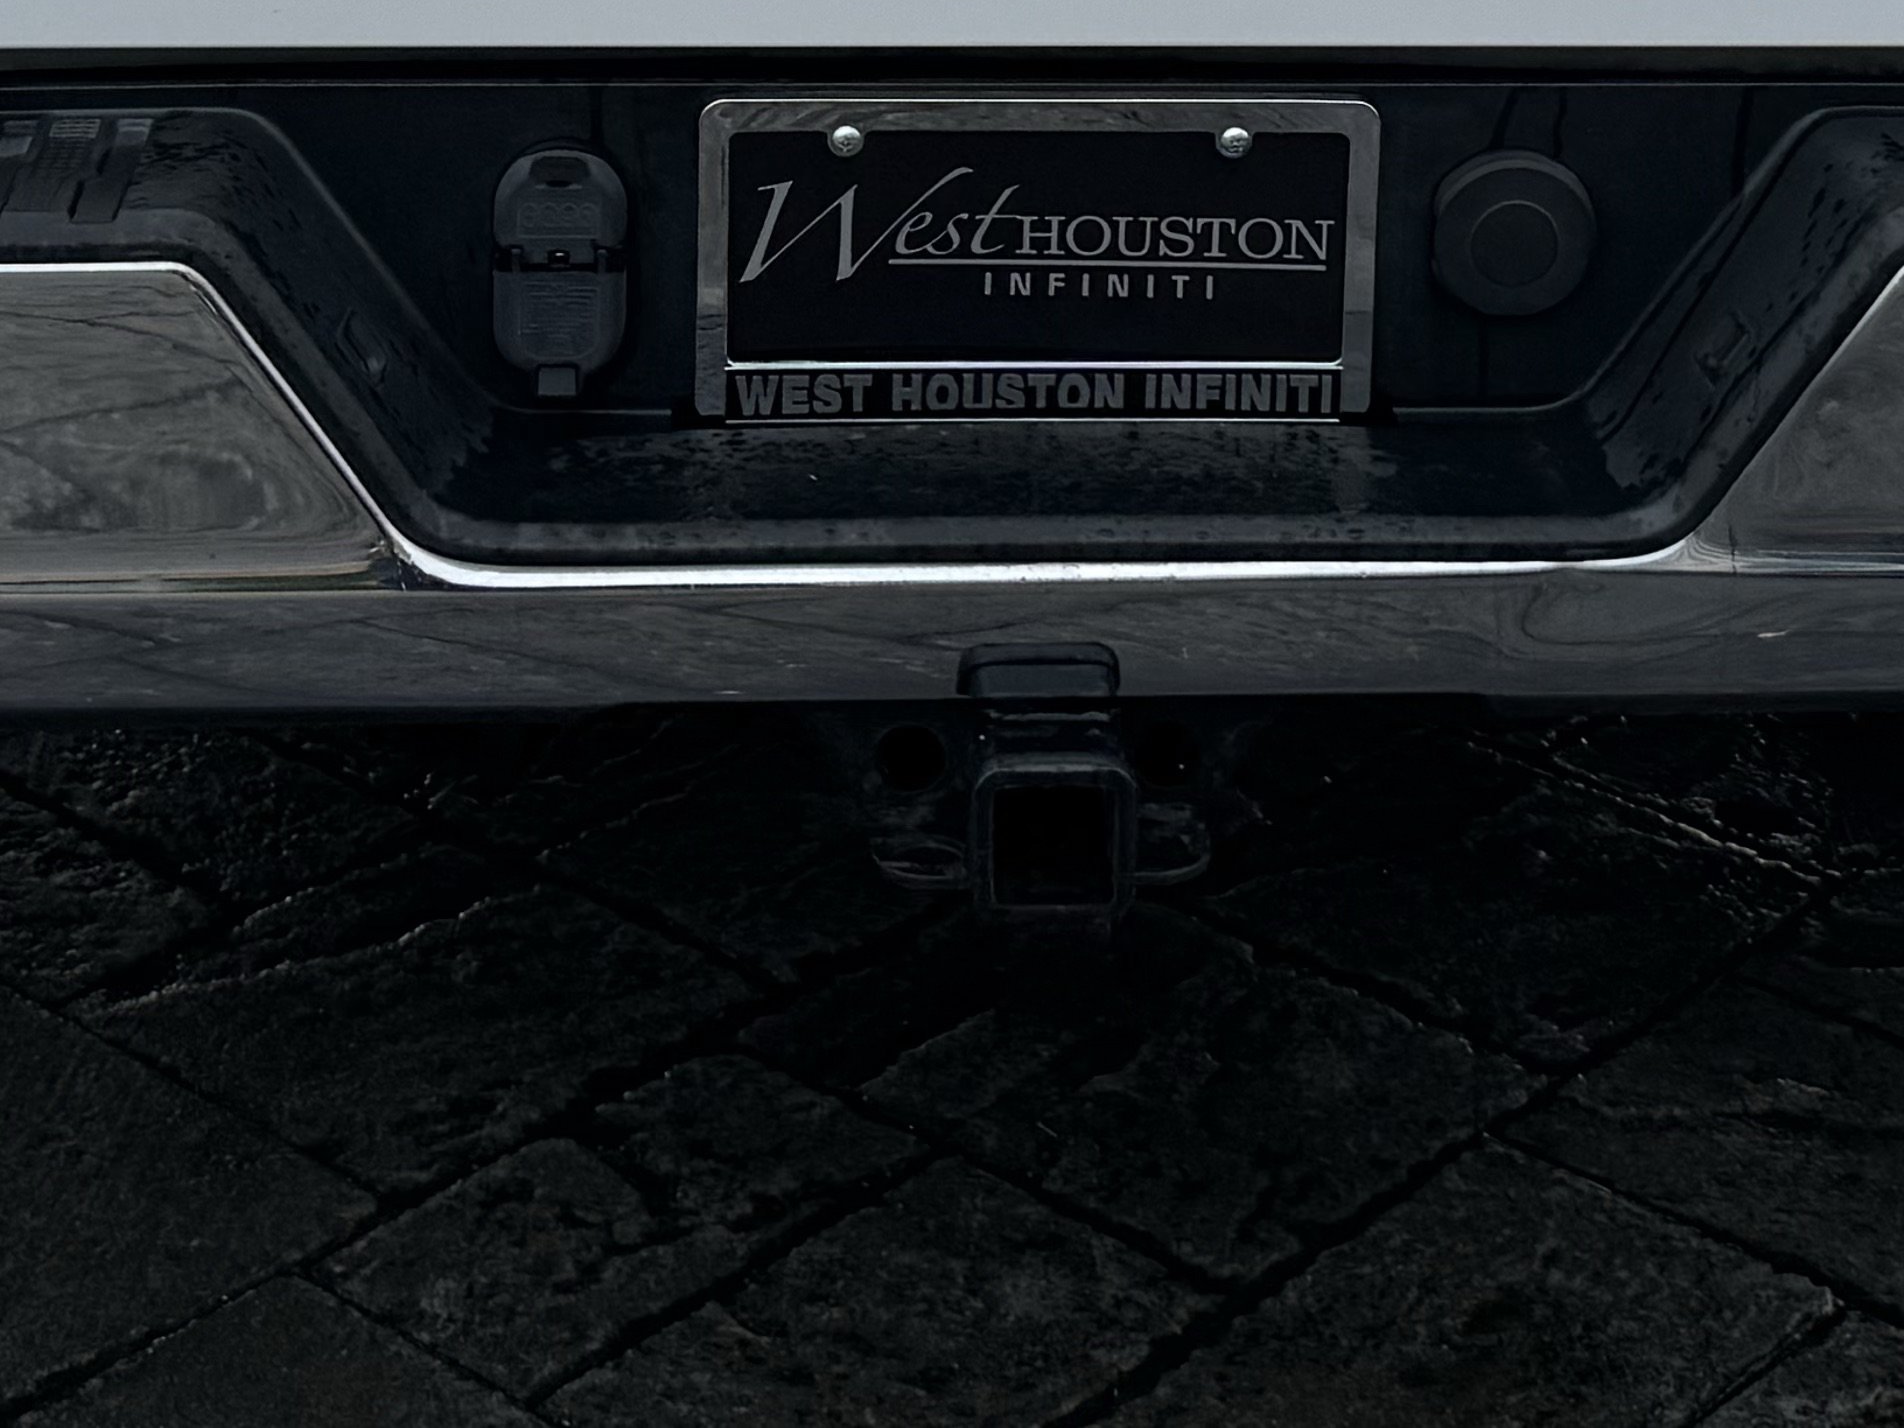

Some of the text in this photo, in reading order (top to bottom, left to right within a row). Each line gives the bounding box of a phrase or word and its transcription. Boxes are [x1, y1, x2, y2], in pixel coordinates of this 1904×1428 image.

[739, 166, 1335, 284] West HOUSTON
[984, 271, 1215, 301] INFINITI
[736, 372, 1334, 417] WEST HOUSTON INFINITI
